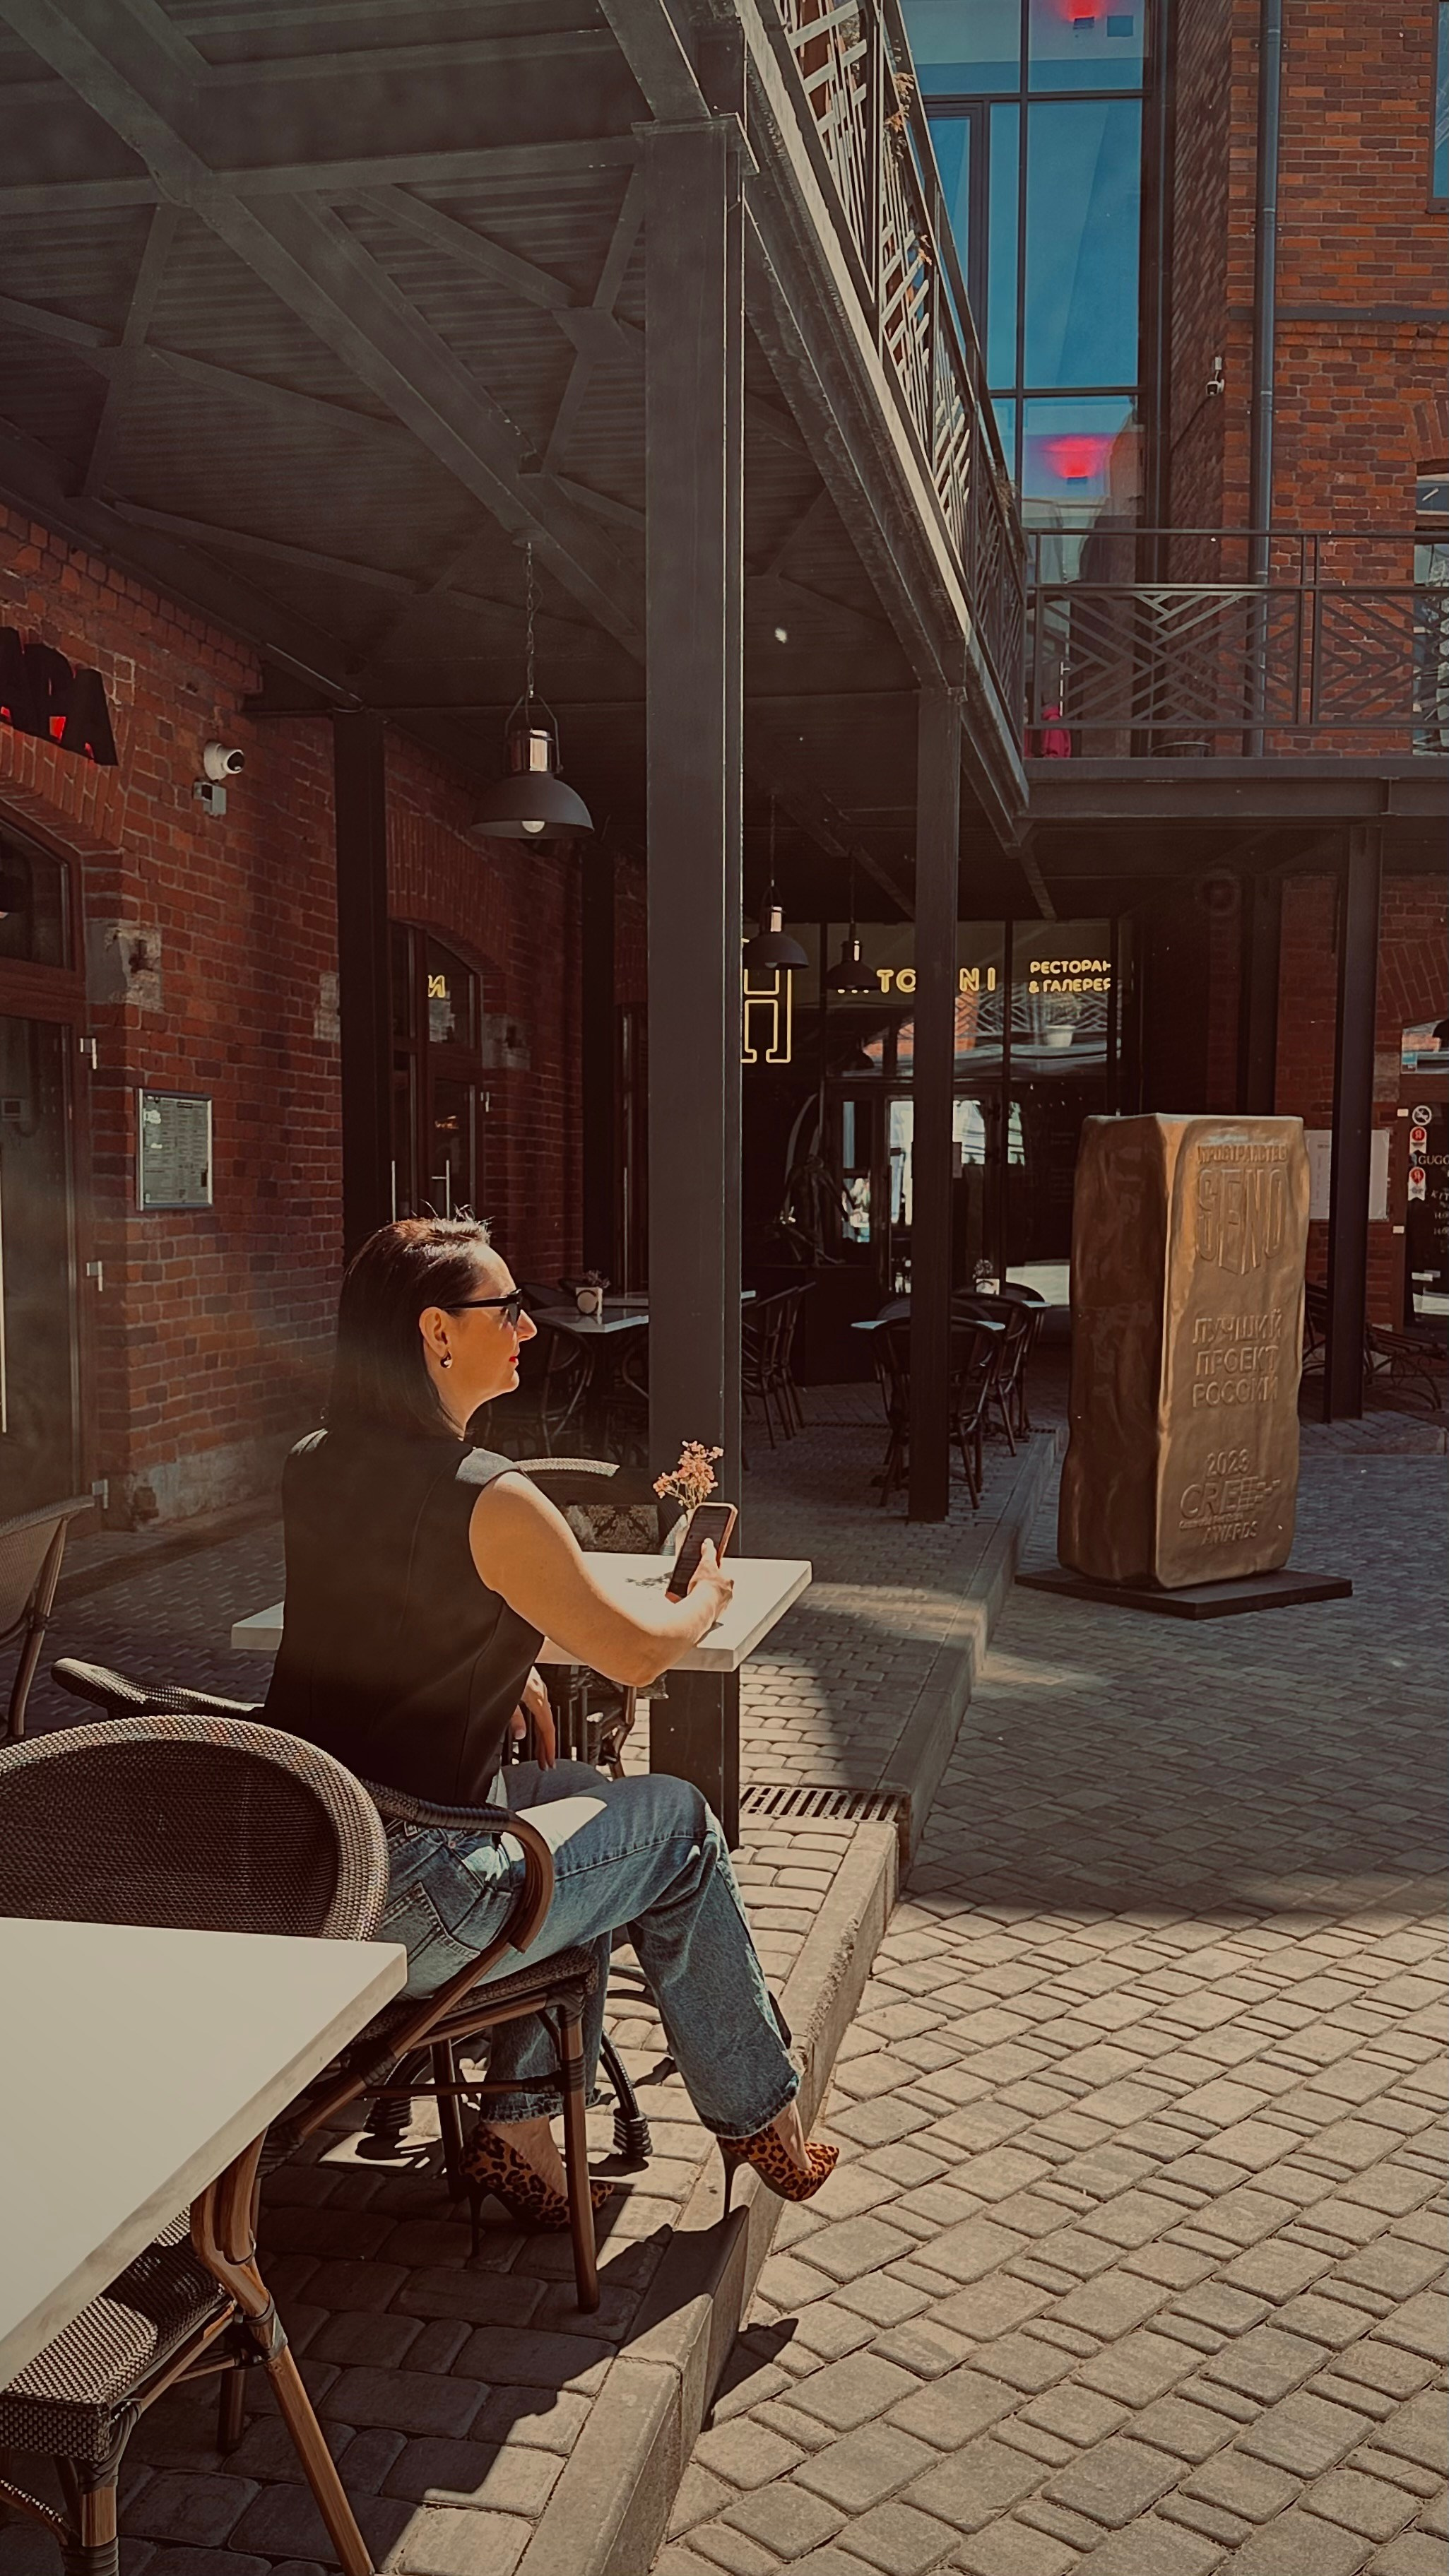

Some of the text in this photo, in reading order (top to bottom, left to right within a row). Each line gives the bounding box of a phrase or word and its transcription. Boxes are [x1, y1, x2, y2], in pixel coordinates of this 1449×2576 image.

[1029, 981, 1039, 994] &
[1196, 1168, 1287, 1275] SENO
[1192, 1308, 1283, 1345] ЛУЧШИЙ
[1195, 1345, 1279, 1376] ПРОЕКТ
[1192, 1376, 1279, 1407] РОССИИ
[1205, 1448, 1250, 1477] 2023
